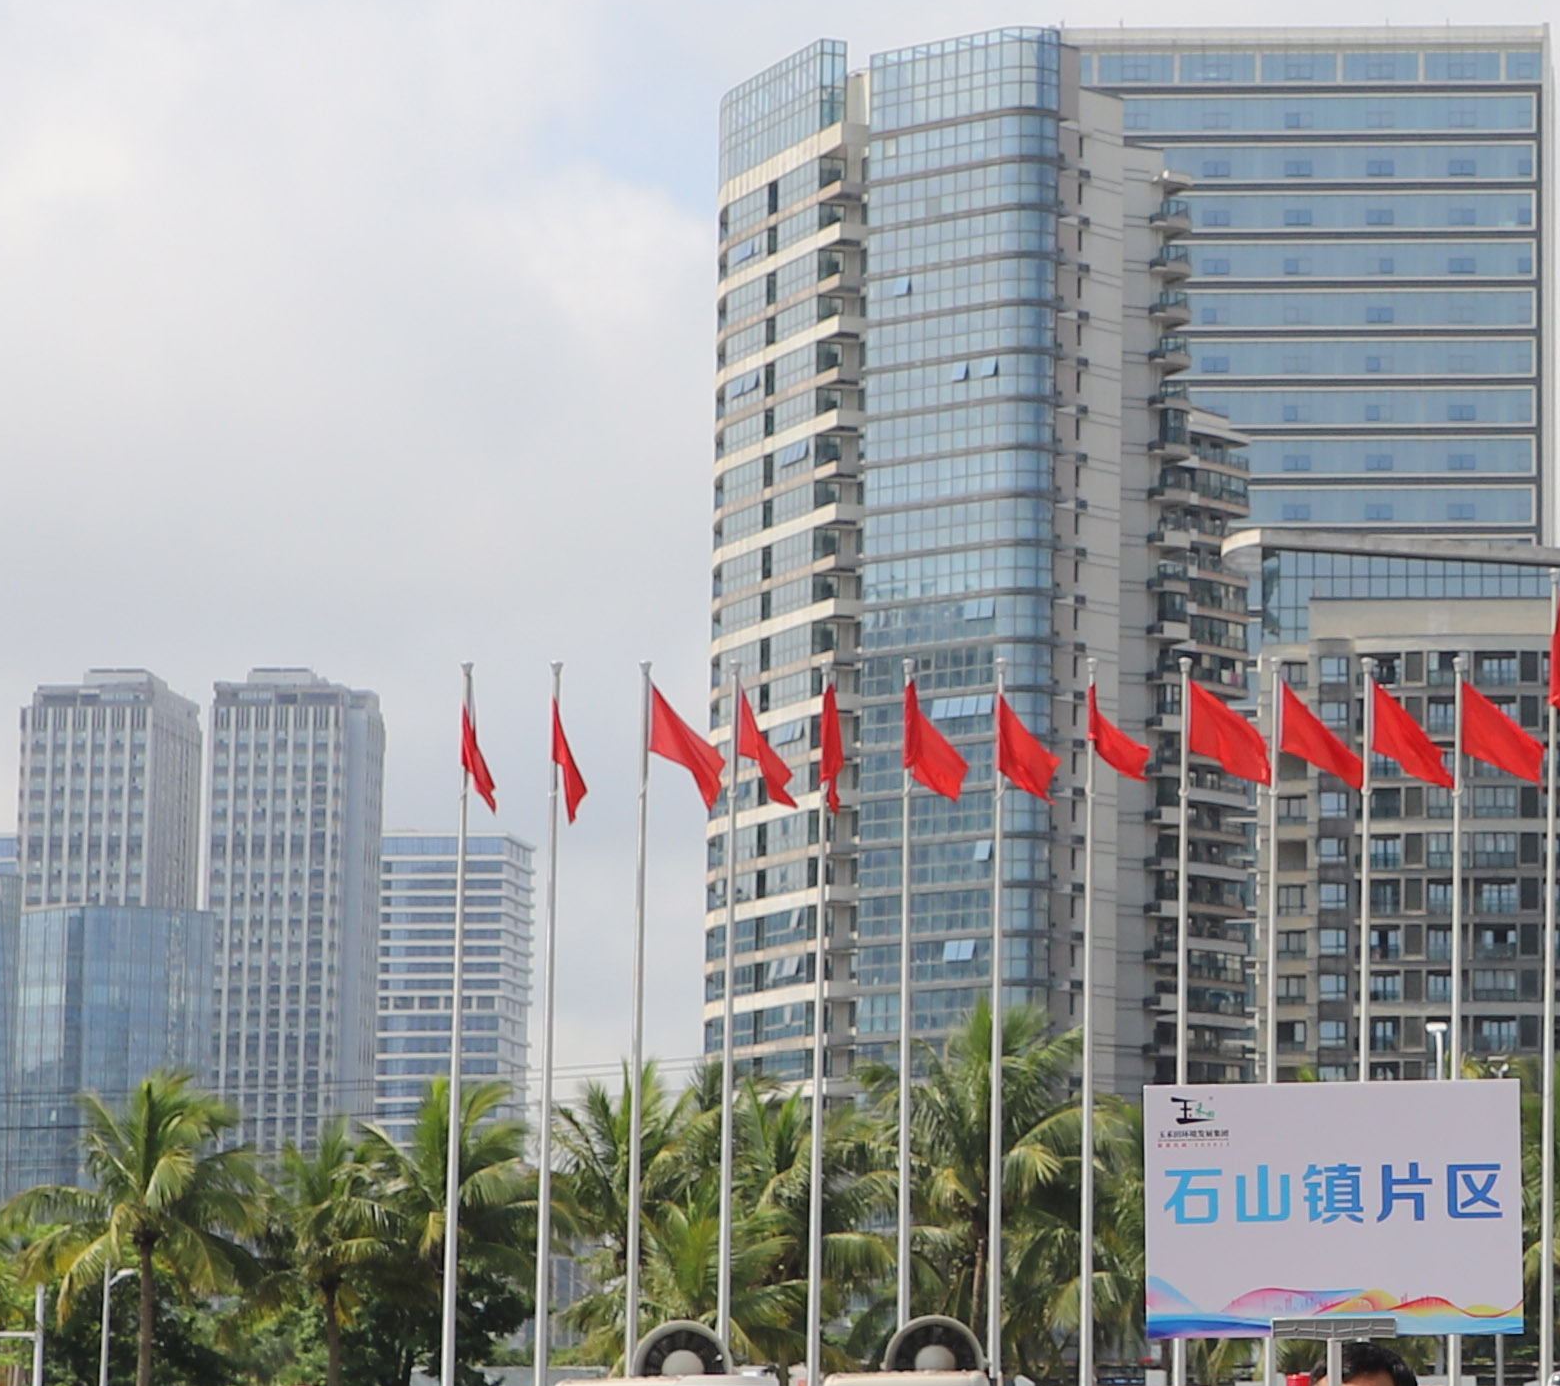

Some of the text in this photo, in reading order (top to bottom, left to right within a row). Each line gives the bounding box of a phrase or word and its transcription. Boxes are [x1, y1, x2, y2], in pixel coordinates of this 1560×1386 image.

[1164, 1162, 1503, 1226] 石山镇片区
